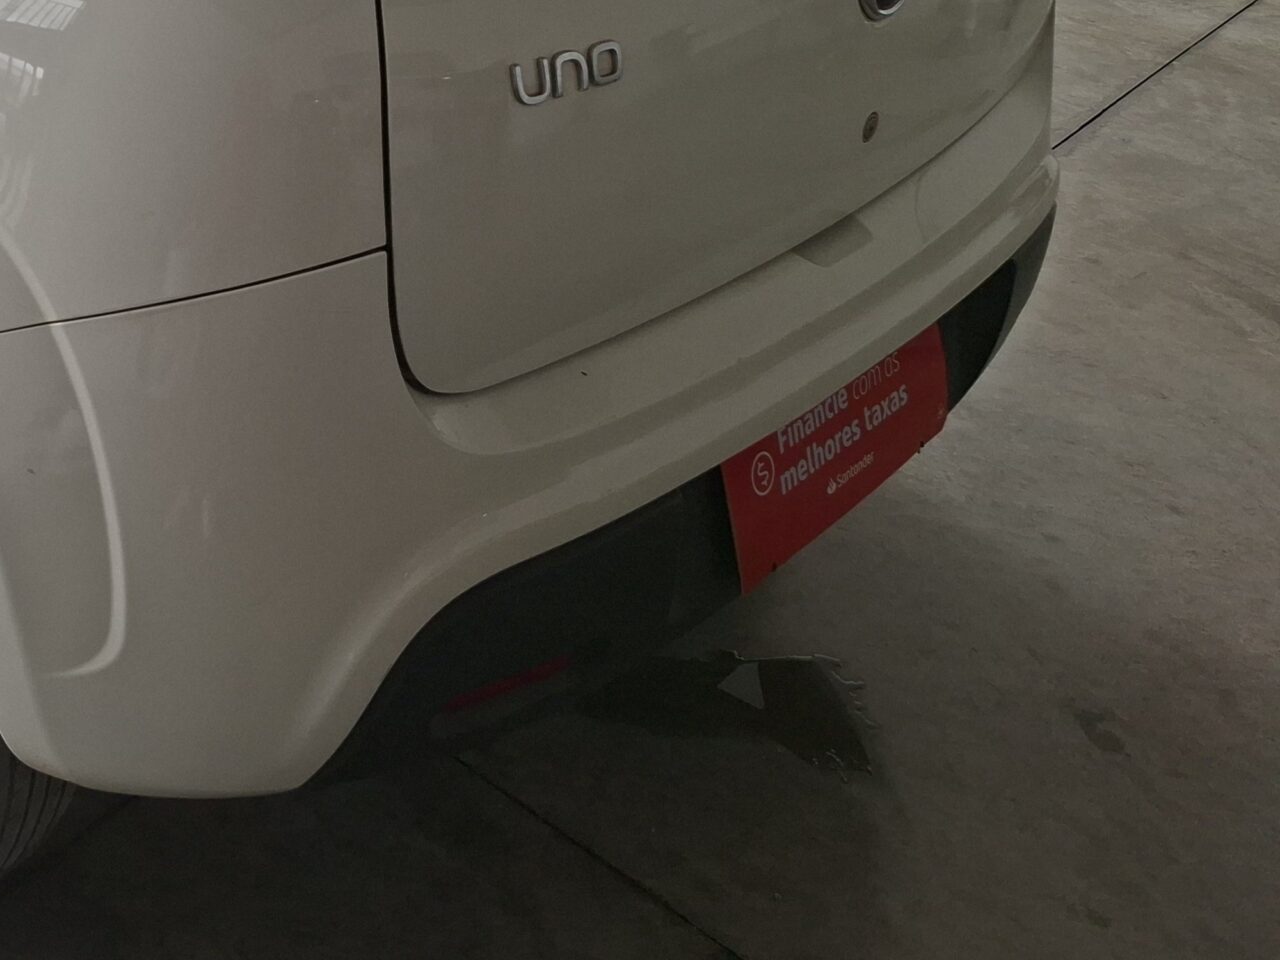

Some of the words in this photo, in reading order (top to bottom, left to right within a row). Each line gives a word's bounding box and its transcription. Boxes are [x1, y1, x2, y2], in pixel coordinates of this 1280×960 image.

[776, 388, 849, 455] Financie
[852, 367, 883, 400] com
[884, 351, 901, 378] as
[780, 419, 862, 495] melhores
[863, 384, 909, 431] taxas
[836, 451, 875, 489] Santander
